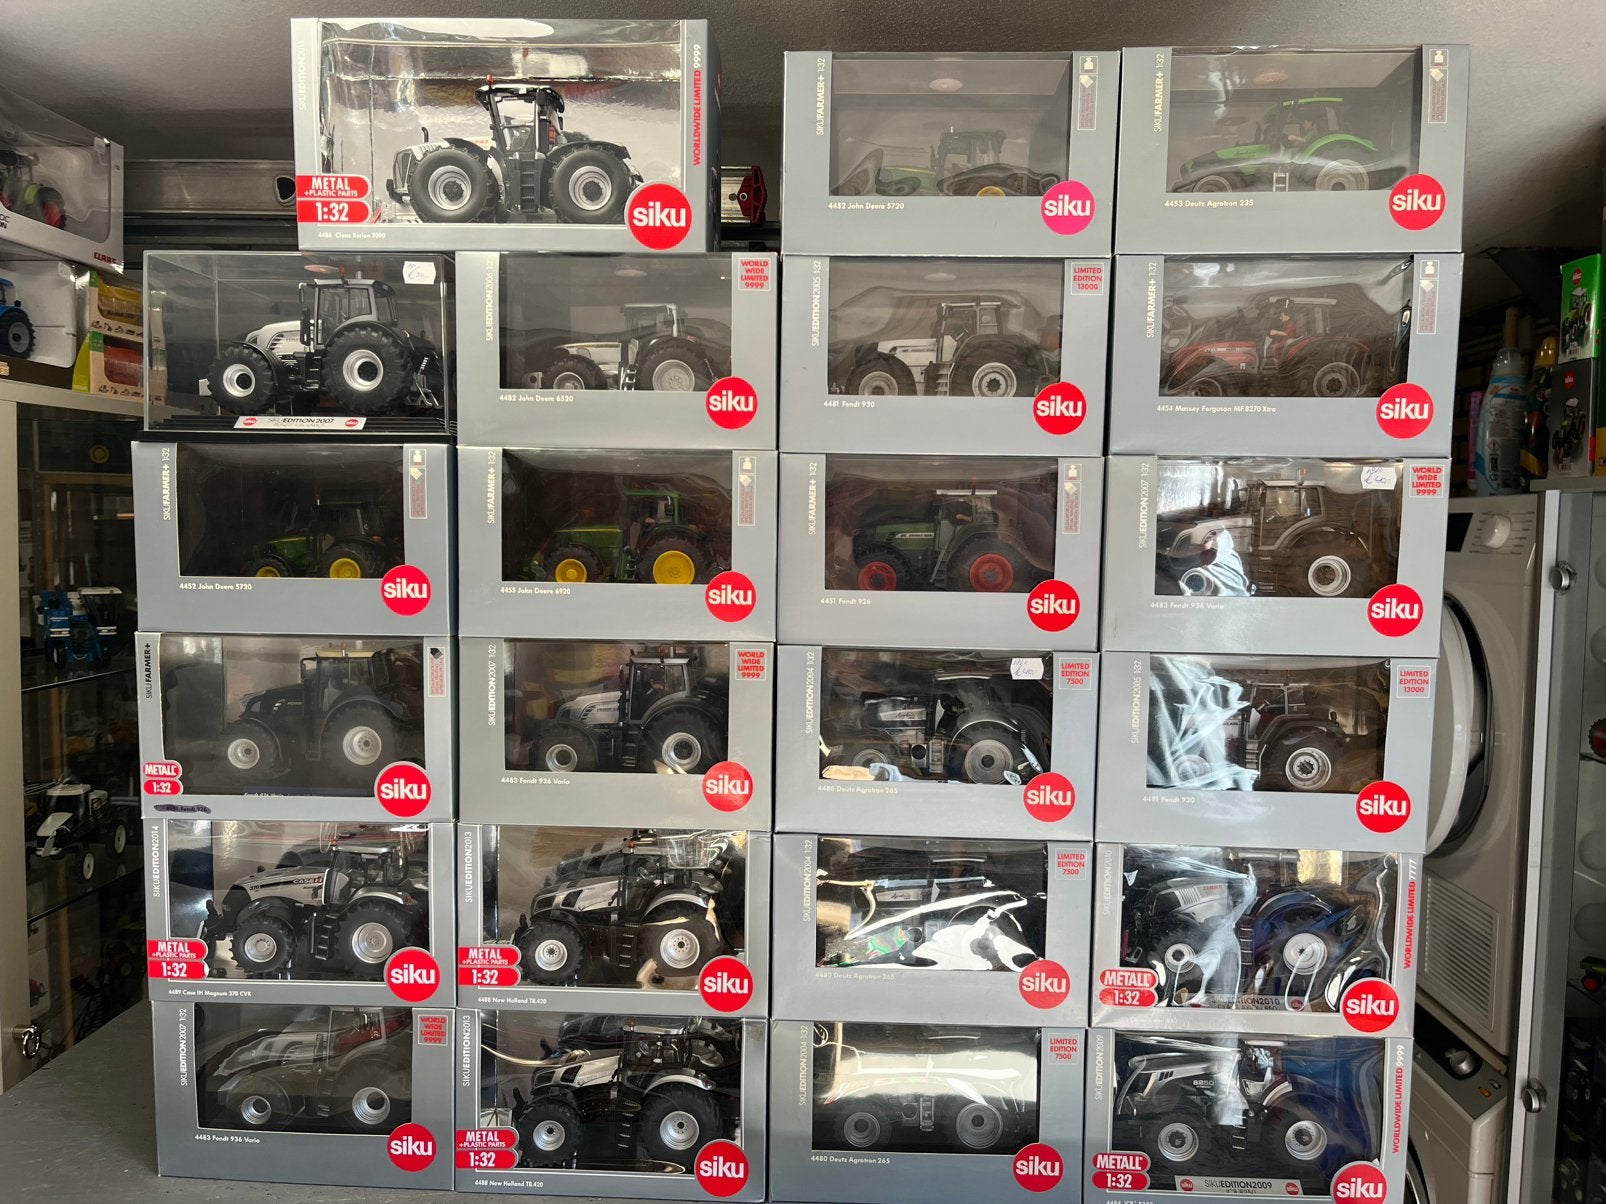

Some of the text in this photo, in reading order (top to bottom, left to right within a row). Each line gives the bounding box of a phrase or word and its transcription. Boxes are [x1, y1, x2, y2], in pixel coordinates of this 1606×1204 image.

[692, 44, 702, 166] WORLDWIDE LIMITED 9999
[816, 74, 825, 136] SIKUFARMER+
[1153, 70, 1164, 132] SIKUFARMER+
[311, 175, 350, 190] METAL
[828, 202, 905, 210] 4452 John Deere 5720
[1044, 195, 1091, 217] siku
[1206, 200, 1238, 208] Agrotron
[1239, 199, 1254, 207] 235
[1392, 188, 1441, 212] siku
[316, 202, 349, 221] 1:32
[632, 200, 686, 228] siku
[1146, 278, 1156, 338] SIKUFARMER+
[517, 394, 534, 402] John
[535, 394, 555, 402] Deere
[708, 390, 754, 412] siku
[861, 400, 876, 408] 930
[1036, 396, 1083, 418] siku
[1174, 405, 1200, 413] Massey
[1201, 405, 1232, 413] Ferguson
[1245, 405, 1262, 413] 8270
[1262, 405, 1277, 413] Xtra
[1380, 398, 1429, 420] siku
[162, 448, 171, 520] SIKUFARMER+ 1:32
[487, 467, 496, 524] SIKUFARMER+
[808, 478, 817, 535] SIKUFARMER+
[1138, 479, 1149, 548] SIKUEDITION2007
[179, 582, 197, 590] 4452
[197, 582, 214, 590] John
[215, 582, 234, 590] Deere
[384, 578, 428, 599] siku
[534, 587, 554, 595] Deere
[707, 584, 752, 606] siku
[1030, 593, 1076, 615] siku
[1370, 598, 1419, 620] siku
[488, 660, 496, 726] SIKUEDITION2007
[805, 667, 814, 734] SIKUEDITION2004
[152, 782, 171, 793] 1:32
[380, 778, 427, 800] siku
[538, 777, 552, 785] 936
[705, 774, 750, 796] siku
[1026, 785, 1072, 806] siku
[1359, 794, 1407, 816] siku
[151, 825, 161, 898] SIKUEDITION2014
[464, 832, 473, 903] SIKUEDITION2013
[802, 856, 812, 922] SIKUEDITION2004
[1404, 858, 1417, 969] WORLDWIDE LIMITED 7777
[157, 942, 190, 953] METAL
[468, 948, 502, 959] METAL
[161, 962, 187, 977] 1:32
[390, 964, 436, 985] siku
[472, 969, 498, 984] 1:32
[703, 972, 748, 994] siku
[1022, 972, 1066, 993] siku
[1114, 990, 1140, 1005] 1:32
[1345, 994, 1394, 1016] siku
[179, 1023, 188, 1086] SIKUEDITION2007
[462, 1015, 471, 1087] SIKUEDITION2013
[799, 1041, 808, 1106] SIKUEDITION2004
[1094, 1034, 1104, 1100] SIKUEDITION2009
[1392, 1044, 1405, 1154] WORLDWIDE LIMITED 9999
[212, 1134, 229, 1142] Fendt
[243, 1136, 260, 1144] Vario
[390, 1136, 433, 1157] siku
[465, 1131, 498, 1142] METAL
[469, 1152, 496, 1167] 1:32
[699, 1158, 744, 1178] siku
[848, 1156, 877, 1164] Agrotron
[1015, 1156, 1060, 1177] siku
[1106, 1173, 1132, 1188] 1:32
[1204, 1180, 1272, 1189] SIKUEDITION2009
[1336, 1178, 1384, 1199] siku
